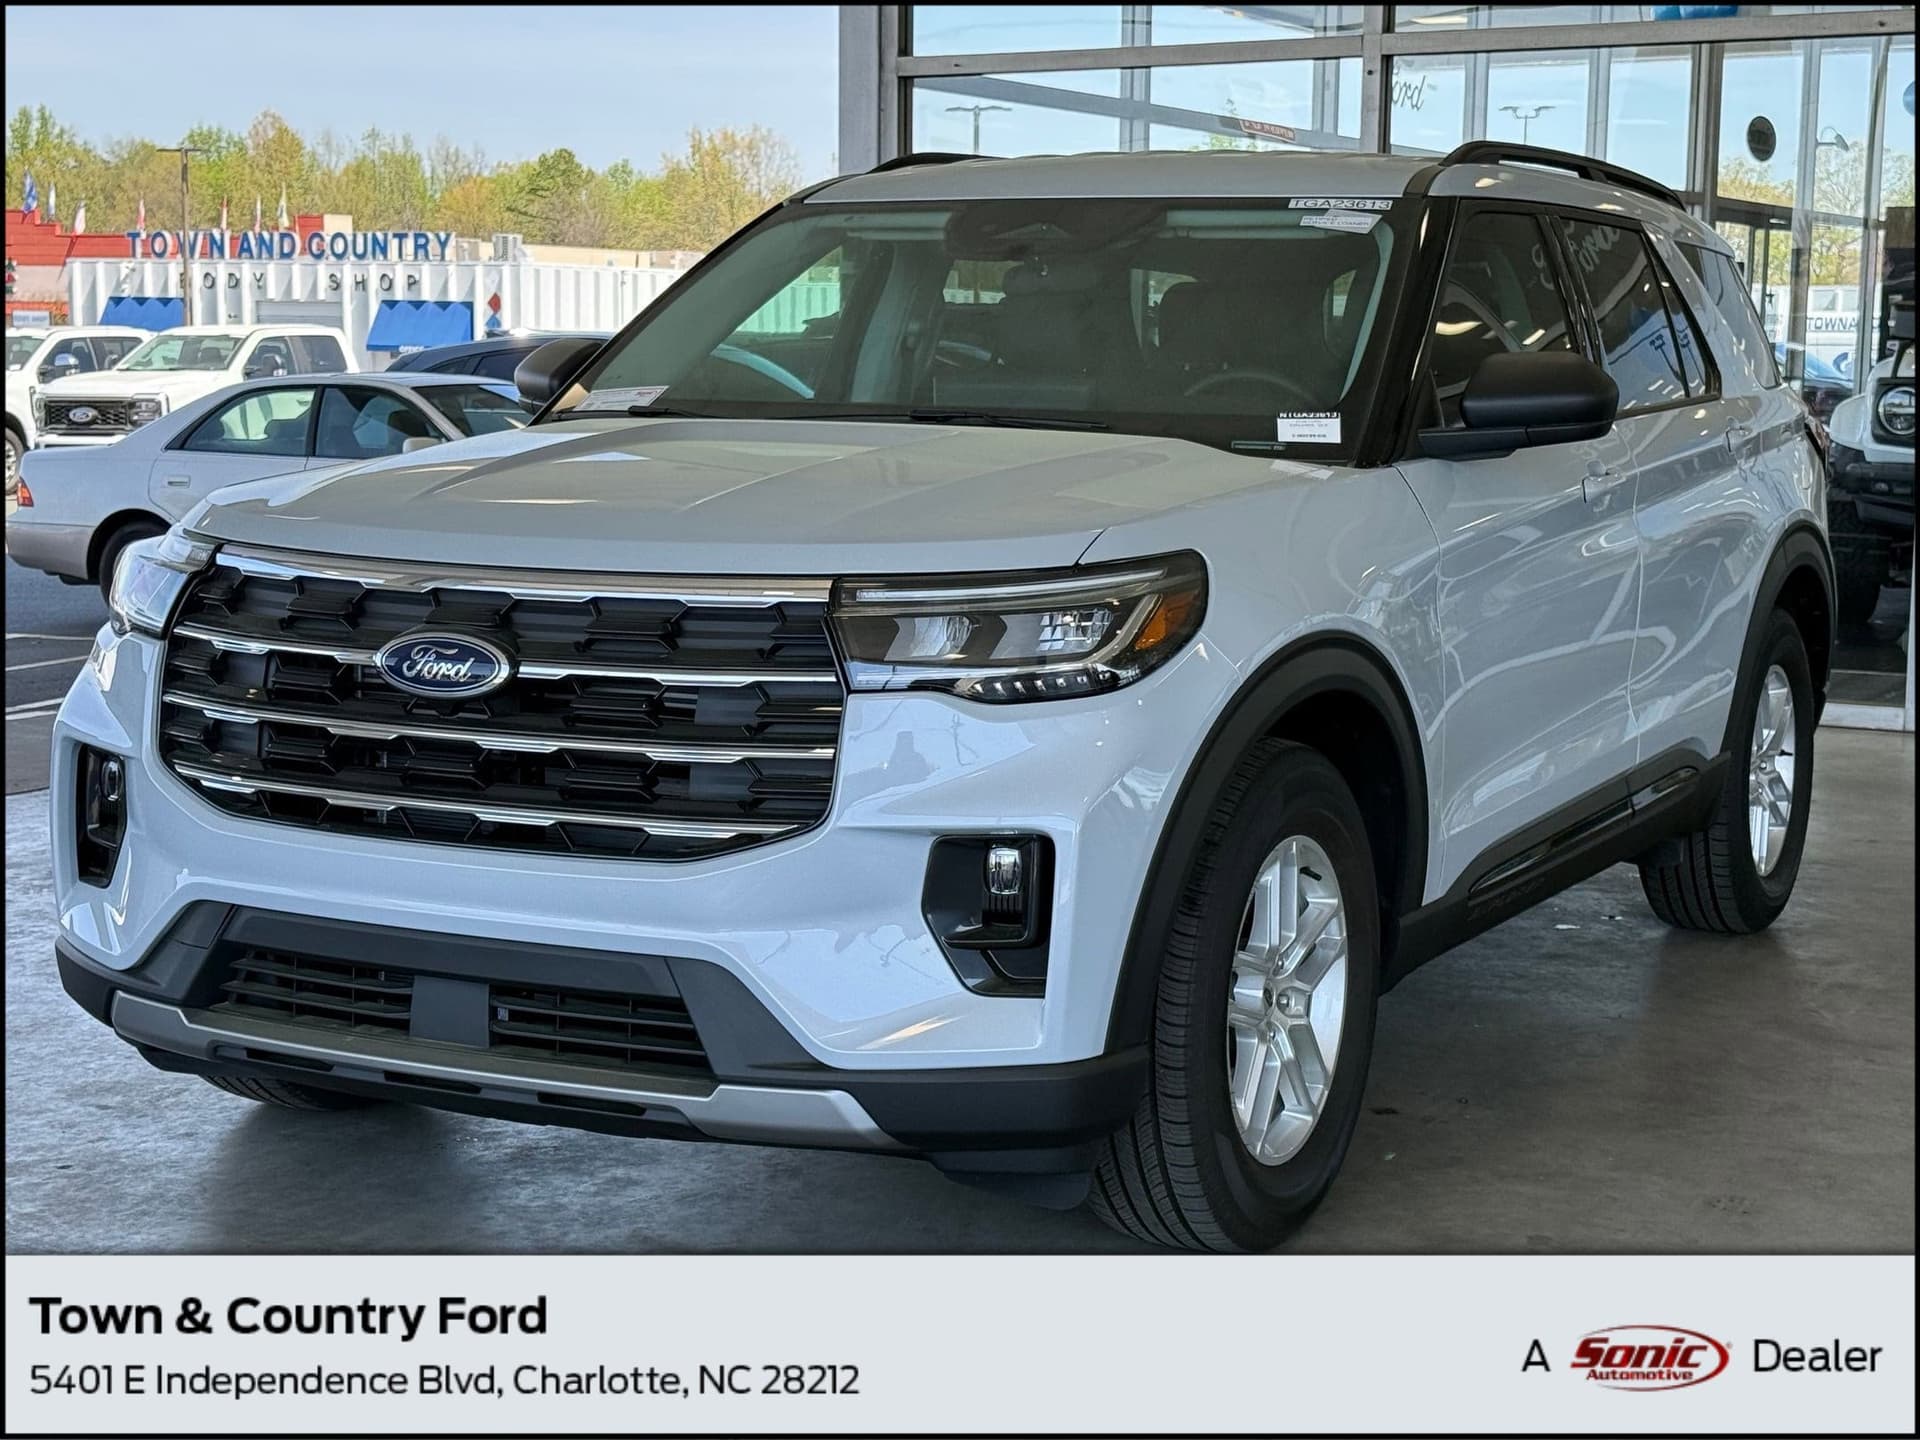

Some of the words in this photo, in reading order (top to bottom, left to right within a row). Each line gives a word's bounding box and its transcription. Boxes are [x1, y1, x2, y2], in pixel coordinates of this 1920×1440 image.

[1294, 199, 1390, 209] TGA23613
[127, 231, 225, 259] TOWN
[238, 231, 296, 260] AND
[307, 231, 451, 262] COUNTRY
[328, 272, 418, 292] SHOP
[402, 644, 475, 682] Ford
